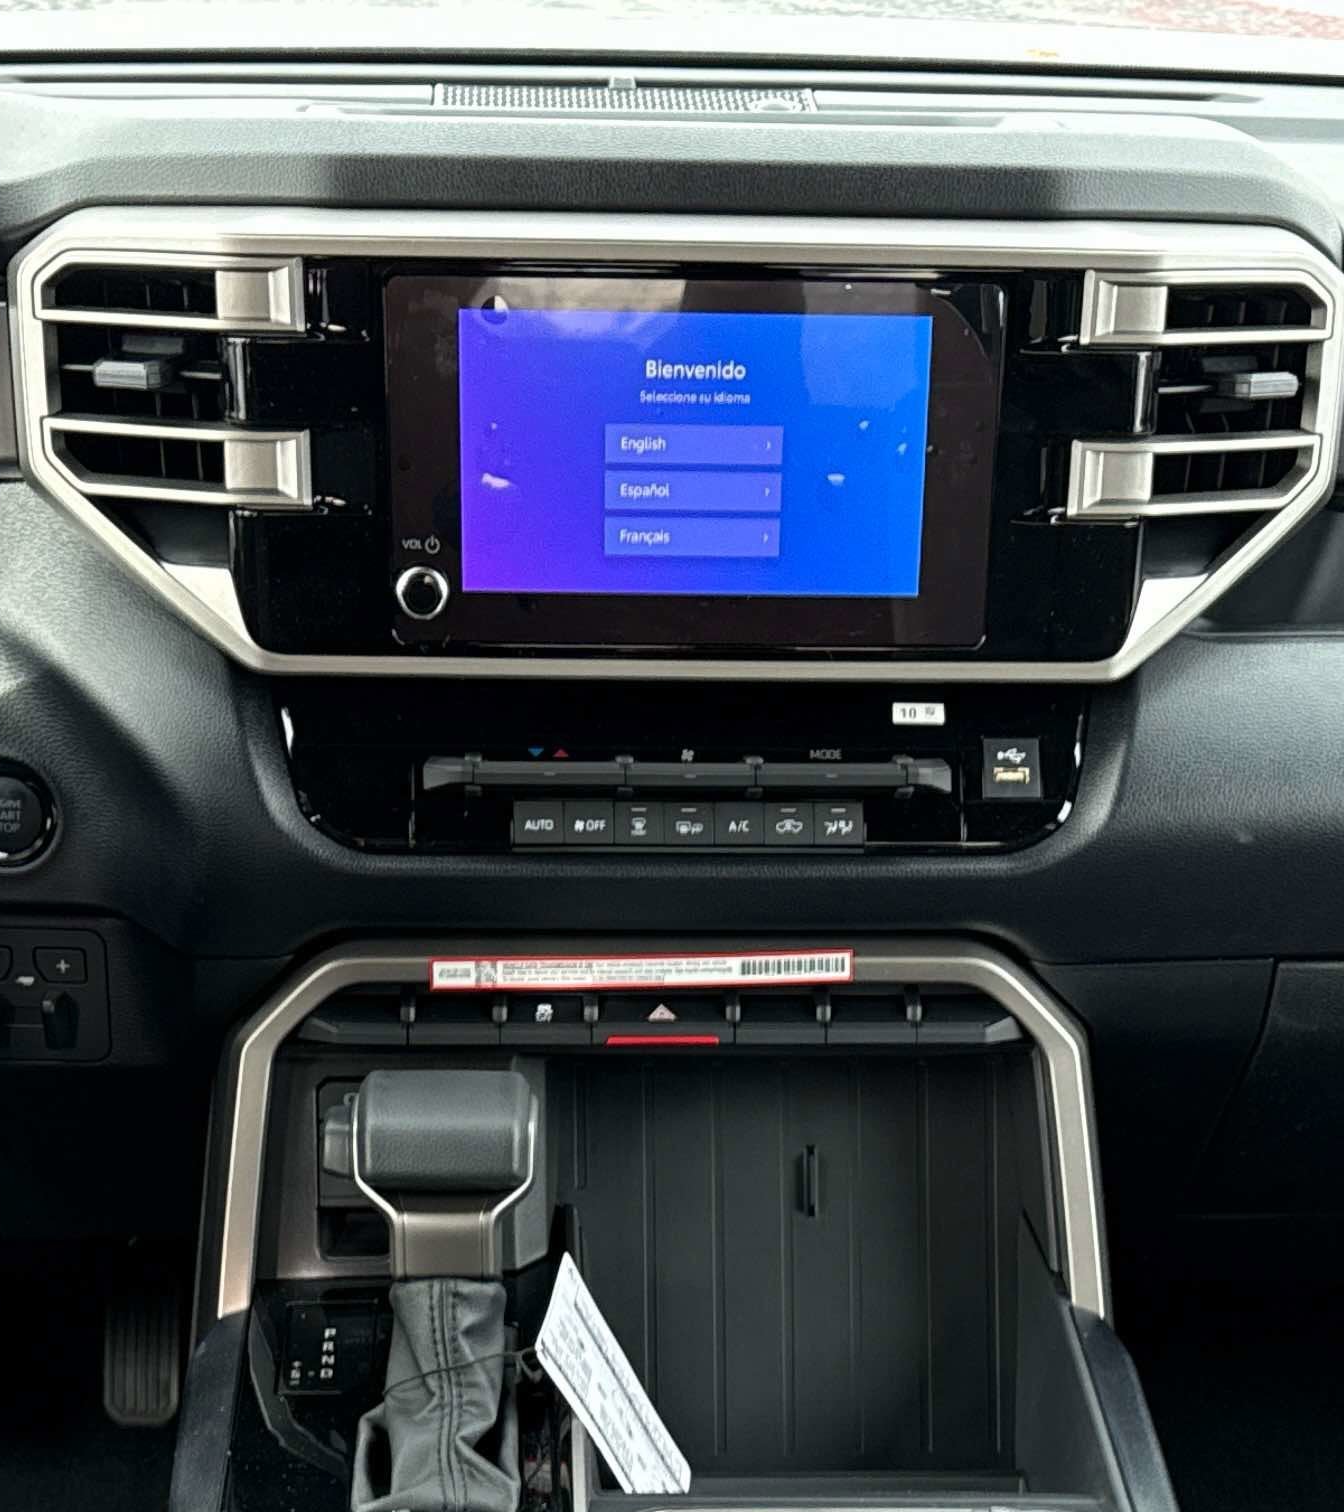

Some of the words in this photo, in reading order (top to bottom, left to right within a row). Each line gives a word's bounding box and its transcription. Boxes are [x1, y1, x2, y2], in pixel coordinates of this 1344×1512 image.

[645, 358, 747, 381] Bienvenido
[639, 389, 697, 404] Seleccione
[699, 392, 713, 404] su
[714, 391, 751, 405] idioma
[620, 436, 667, 454] English
[619, 483, 670, 499] Español
[401, 537, 423, 550] VOL
[619, 528, 671, 546] Français
[899, 707, 918, 720] 10
[809, 749, 843, 761] MODE
[524, 819, 555, 831] AUTO
[585, 819, 607, 832] OFF
[728, 819, 750, 833] A/C
[324, 1327, 337, 1339] P
[321, 1354, 335, 1366] N
[319, 1367, 334, 1379] D
